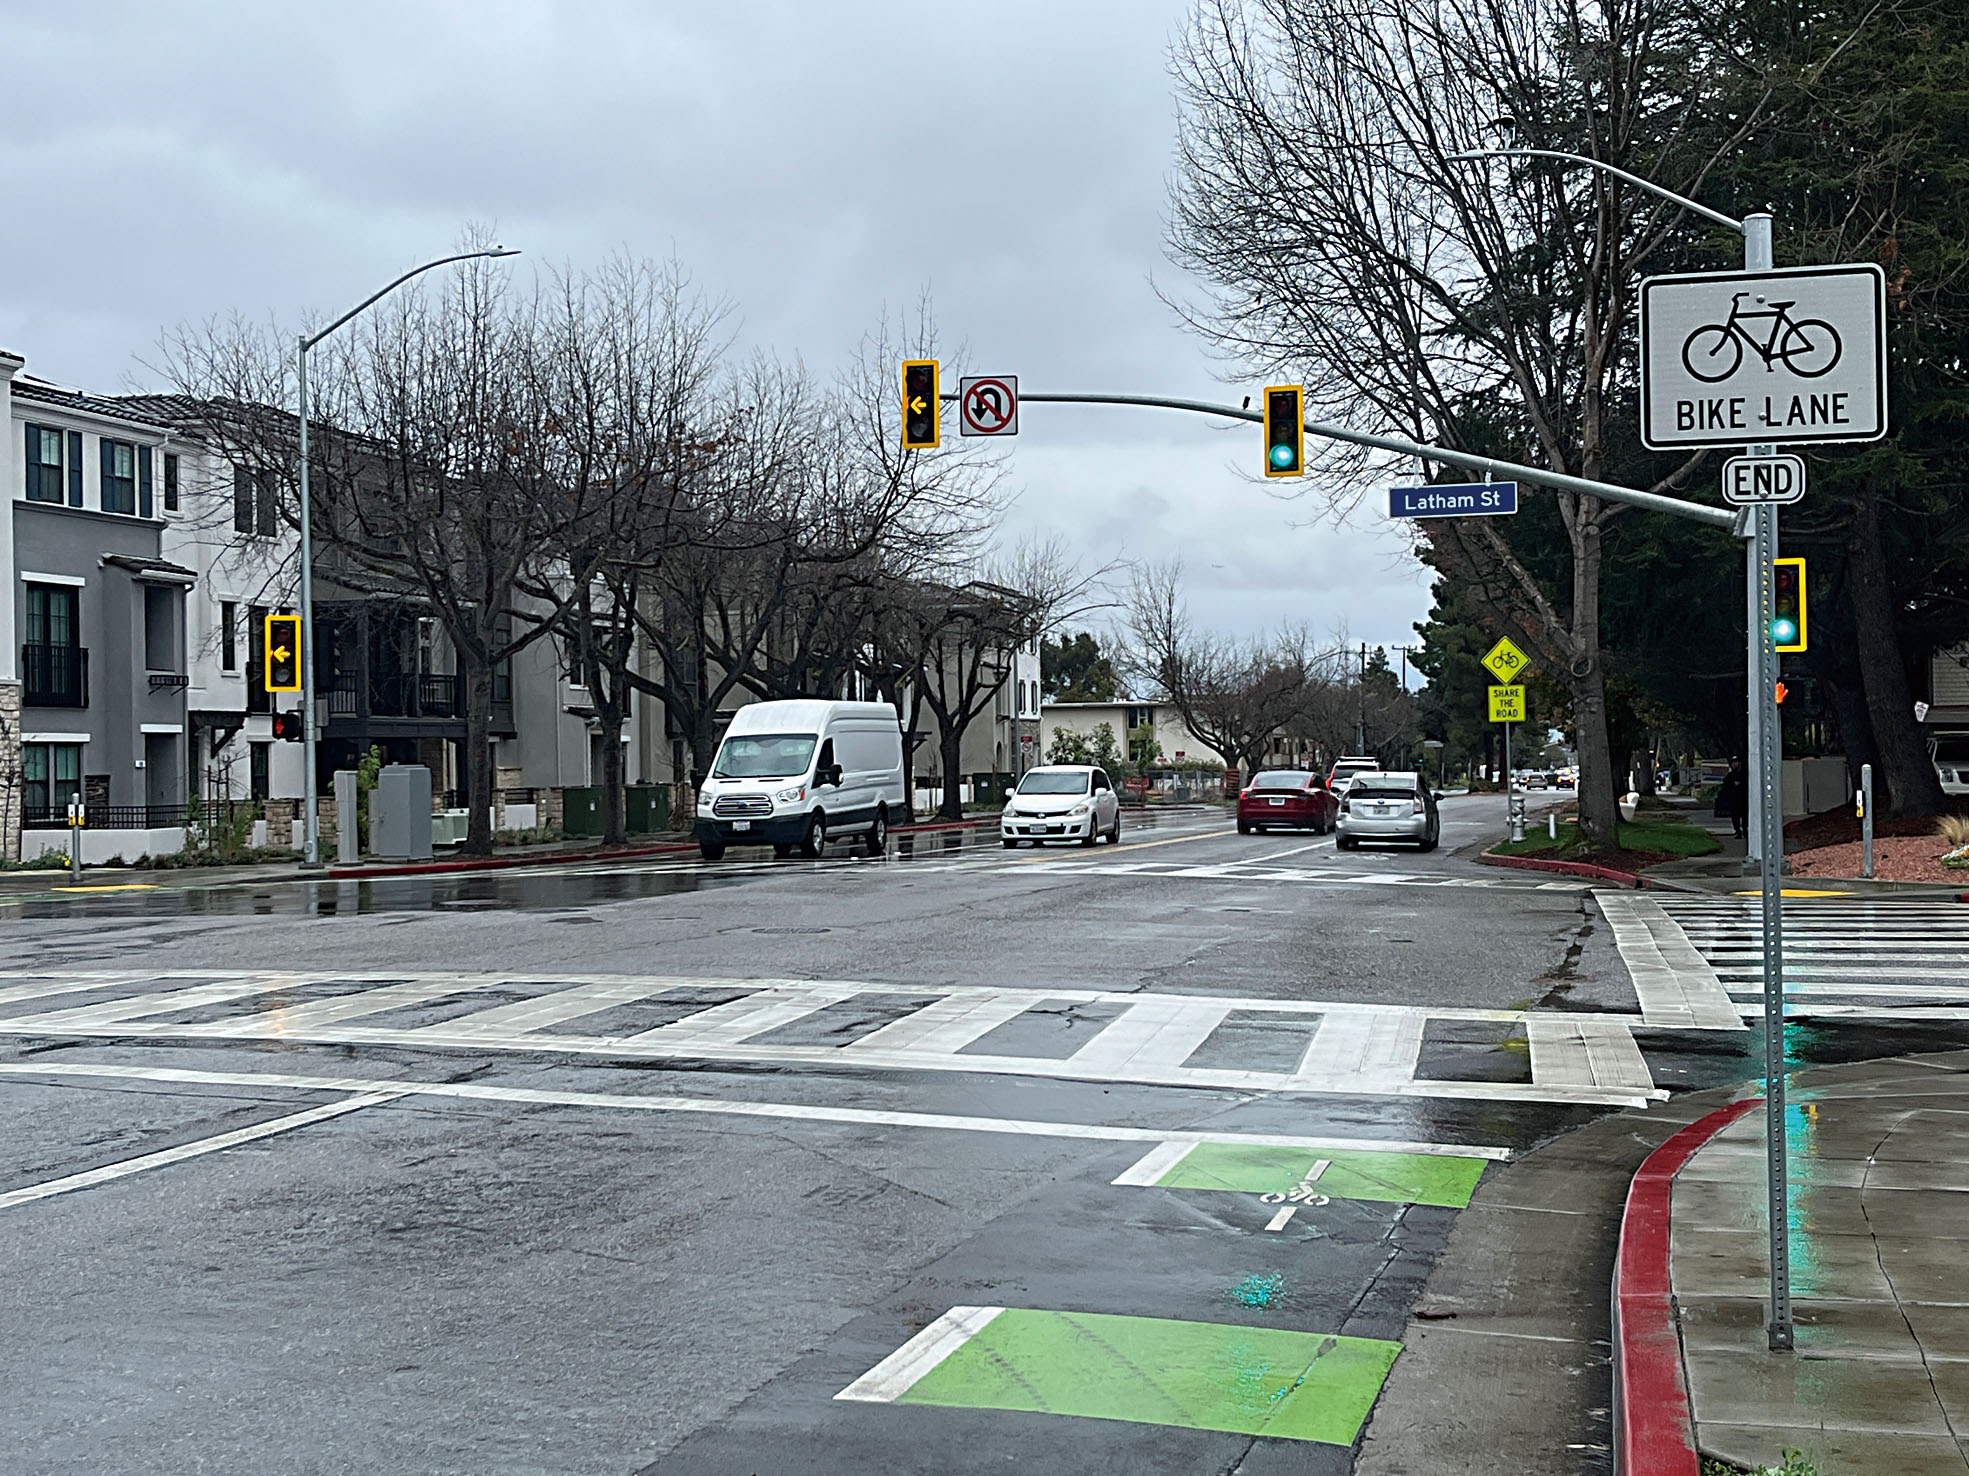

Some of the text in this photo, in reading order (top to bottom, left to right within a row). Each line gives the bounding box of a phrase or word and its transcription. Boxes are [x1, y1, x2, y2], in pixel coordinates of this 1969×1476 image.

[1676, 393, 1850, 431] BIKE LANE
[1734, 464, 1793, 496] END
[1404, 491, 1501, 510] Latham St
[1493, 688, 1520, 698] SHARE
[1499, 699, 1514, 708] THE
[1496, 709, 1518, 718] ROAD
